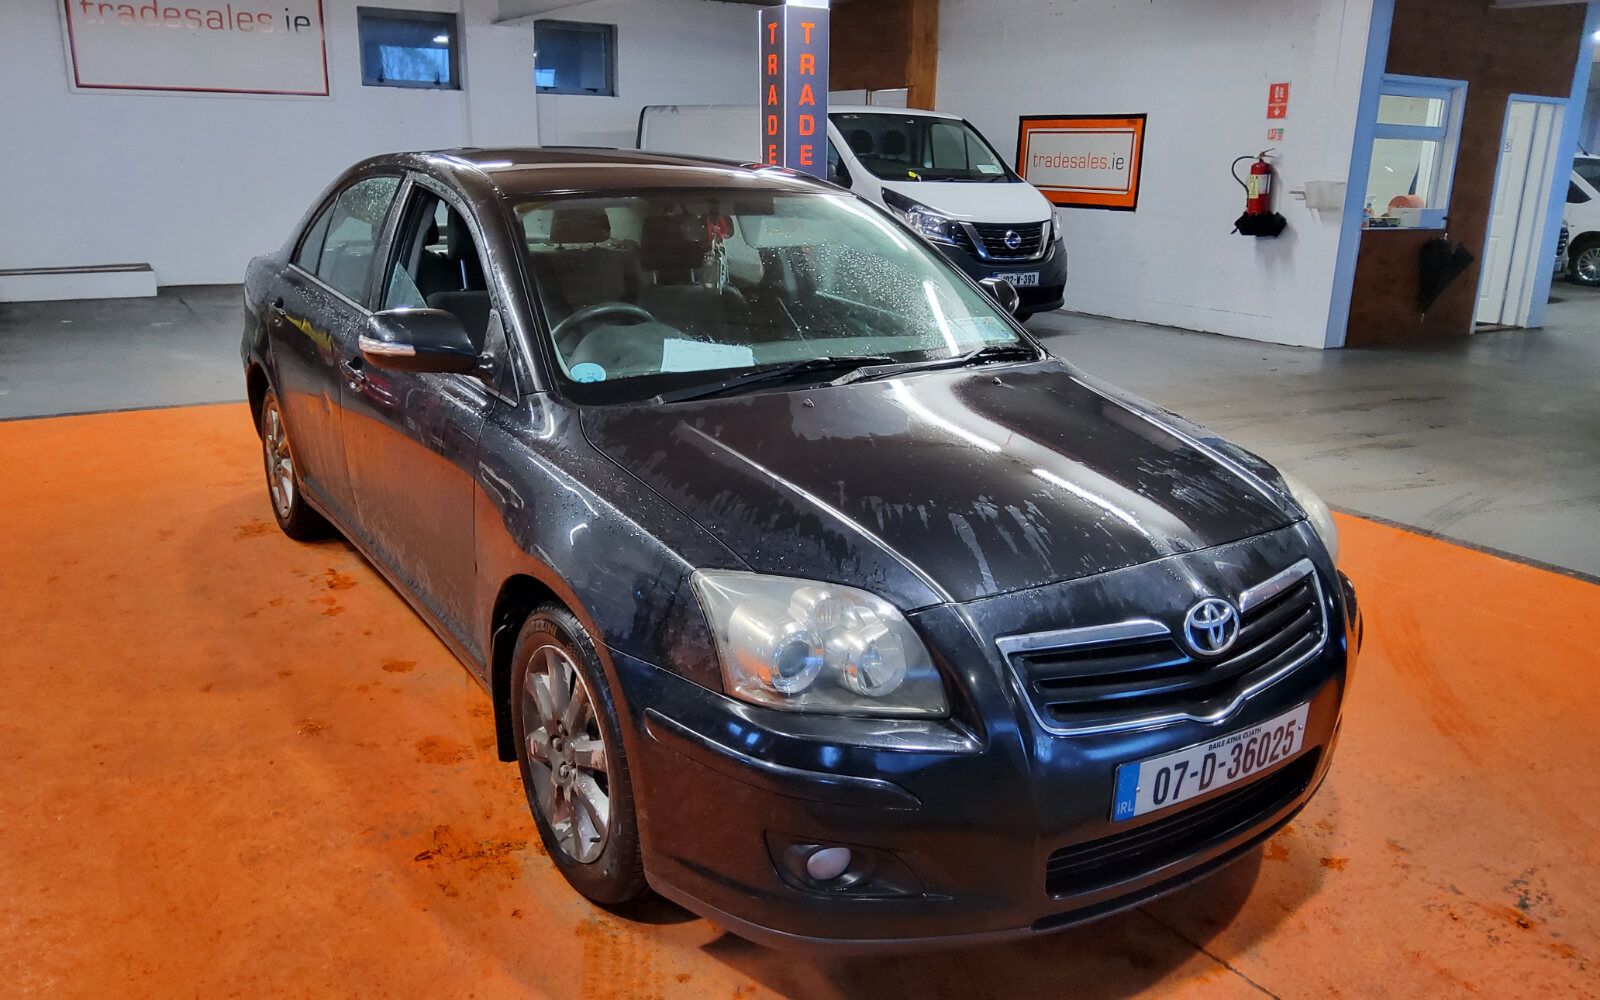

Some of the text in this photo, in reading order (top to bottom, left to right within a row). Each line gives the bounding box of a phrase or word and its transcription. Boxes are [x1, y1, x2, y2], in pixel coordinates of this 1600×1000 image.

[767, 22, 778, 165] TRADE
[798, 22, 815, 166] TRADE
[1032, 152, 1125, 171] tradesales.ie
[1152, 719, 1297, 806] 07-D-36025
[1208, 739, 1226, 751] BAILE
[1242, 727, 1262, 739] CLIATH
[1117, 801, 1134, 816] IRL
